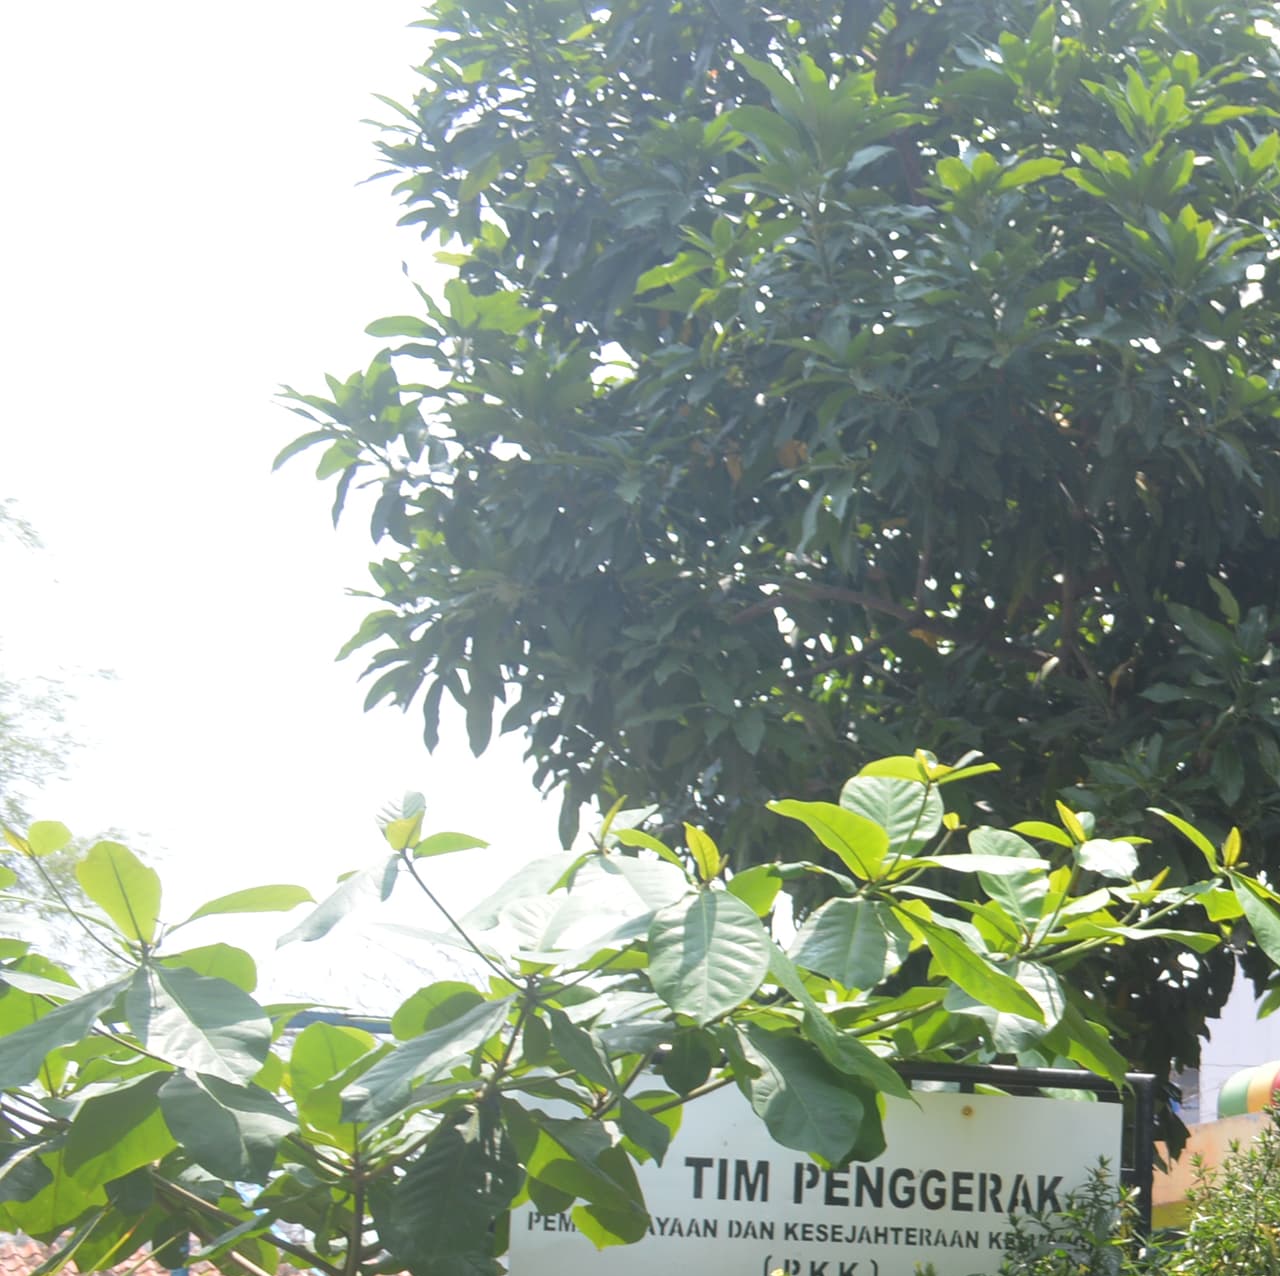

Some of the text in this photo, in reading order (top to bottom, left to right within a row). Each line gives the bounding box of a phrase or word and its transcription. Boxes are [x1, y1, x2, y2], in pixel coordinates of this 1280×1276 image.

[684, 1156, 1065, 1214] TIM PENGGERAK
[728, 1219, 775, 1240] DAN
[784, 1222, 979, 1250] KESEJAHTERAAN
